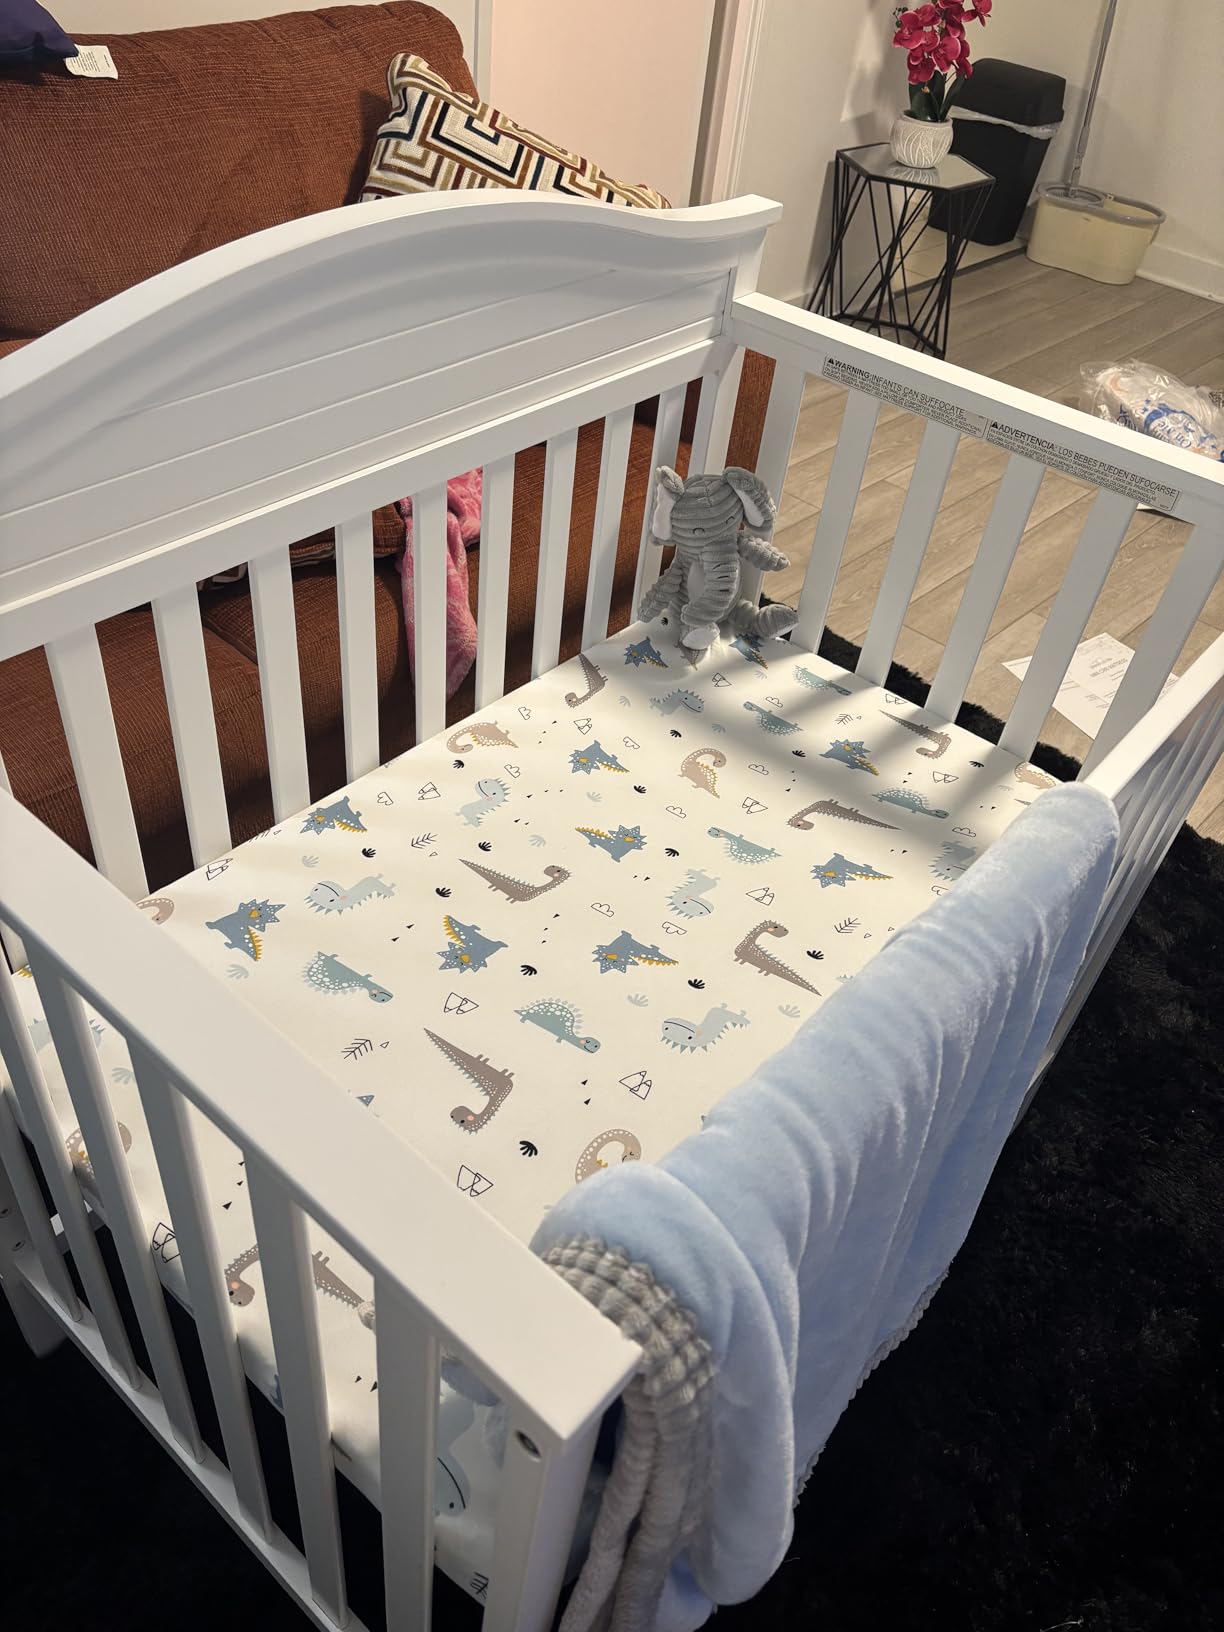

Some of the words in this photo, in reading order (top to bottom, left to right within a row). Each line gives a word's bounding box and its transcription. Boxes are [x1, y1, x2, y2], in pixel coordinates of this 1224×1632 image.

[903, 386, 919, 398] CAN
[920, 393, 963, 415] SUFFOCATE
[1058, 446, 1073, 457] LOS
[1073, 452, 1097, 467] BEBES
[1099, 462, 1127, 478] PUEDEN
[1130, 474, 1175, 496] SUFOCARSE
